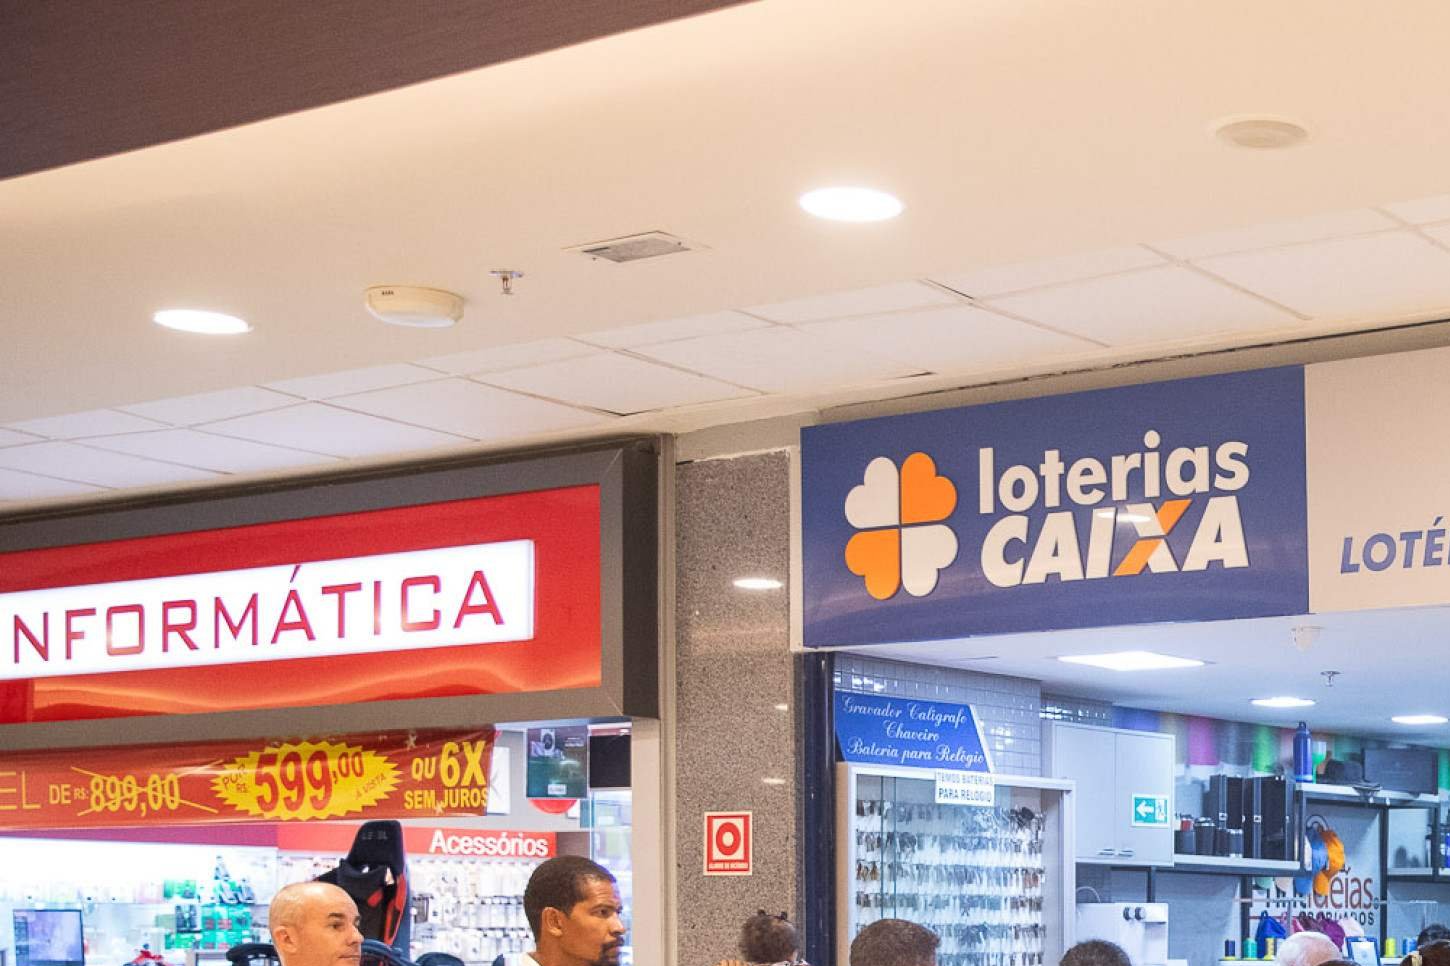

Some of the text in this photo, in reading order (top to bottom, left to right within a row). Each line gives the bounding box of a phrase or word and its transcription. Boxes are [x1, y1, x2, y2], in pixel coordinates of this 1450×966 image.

[978, 429, 1251, 515] loterias
[980, 494, 1251, 589] CAIXA
[842, 694, 903, 717] Gravador
[883, 719, 940, 742] Chaveiro
[439, 739, 488, 788] 6X
[847, 736, 985, 767] Bateria para Relógio
[48, 784, 72, 805] DE
[89, 772, 181, 818] 899,00
[254, 750, 365, 811] 599,00
[938, 787, 959, 799] PARA
[403, 786, 490, 810] SEM JUROS
[429, 829, 549, 857] Acessórios
